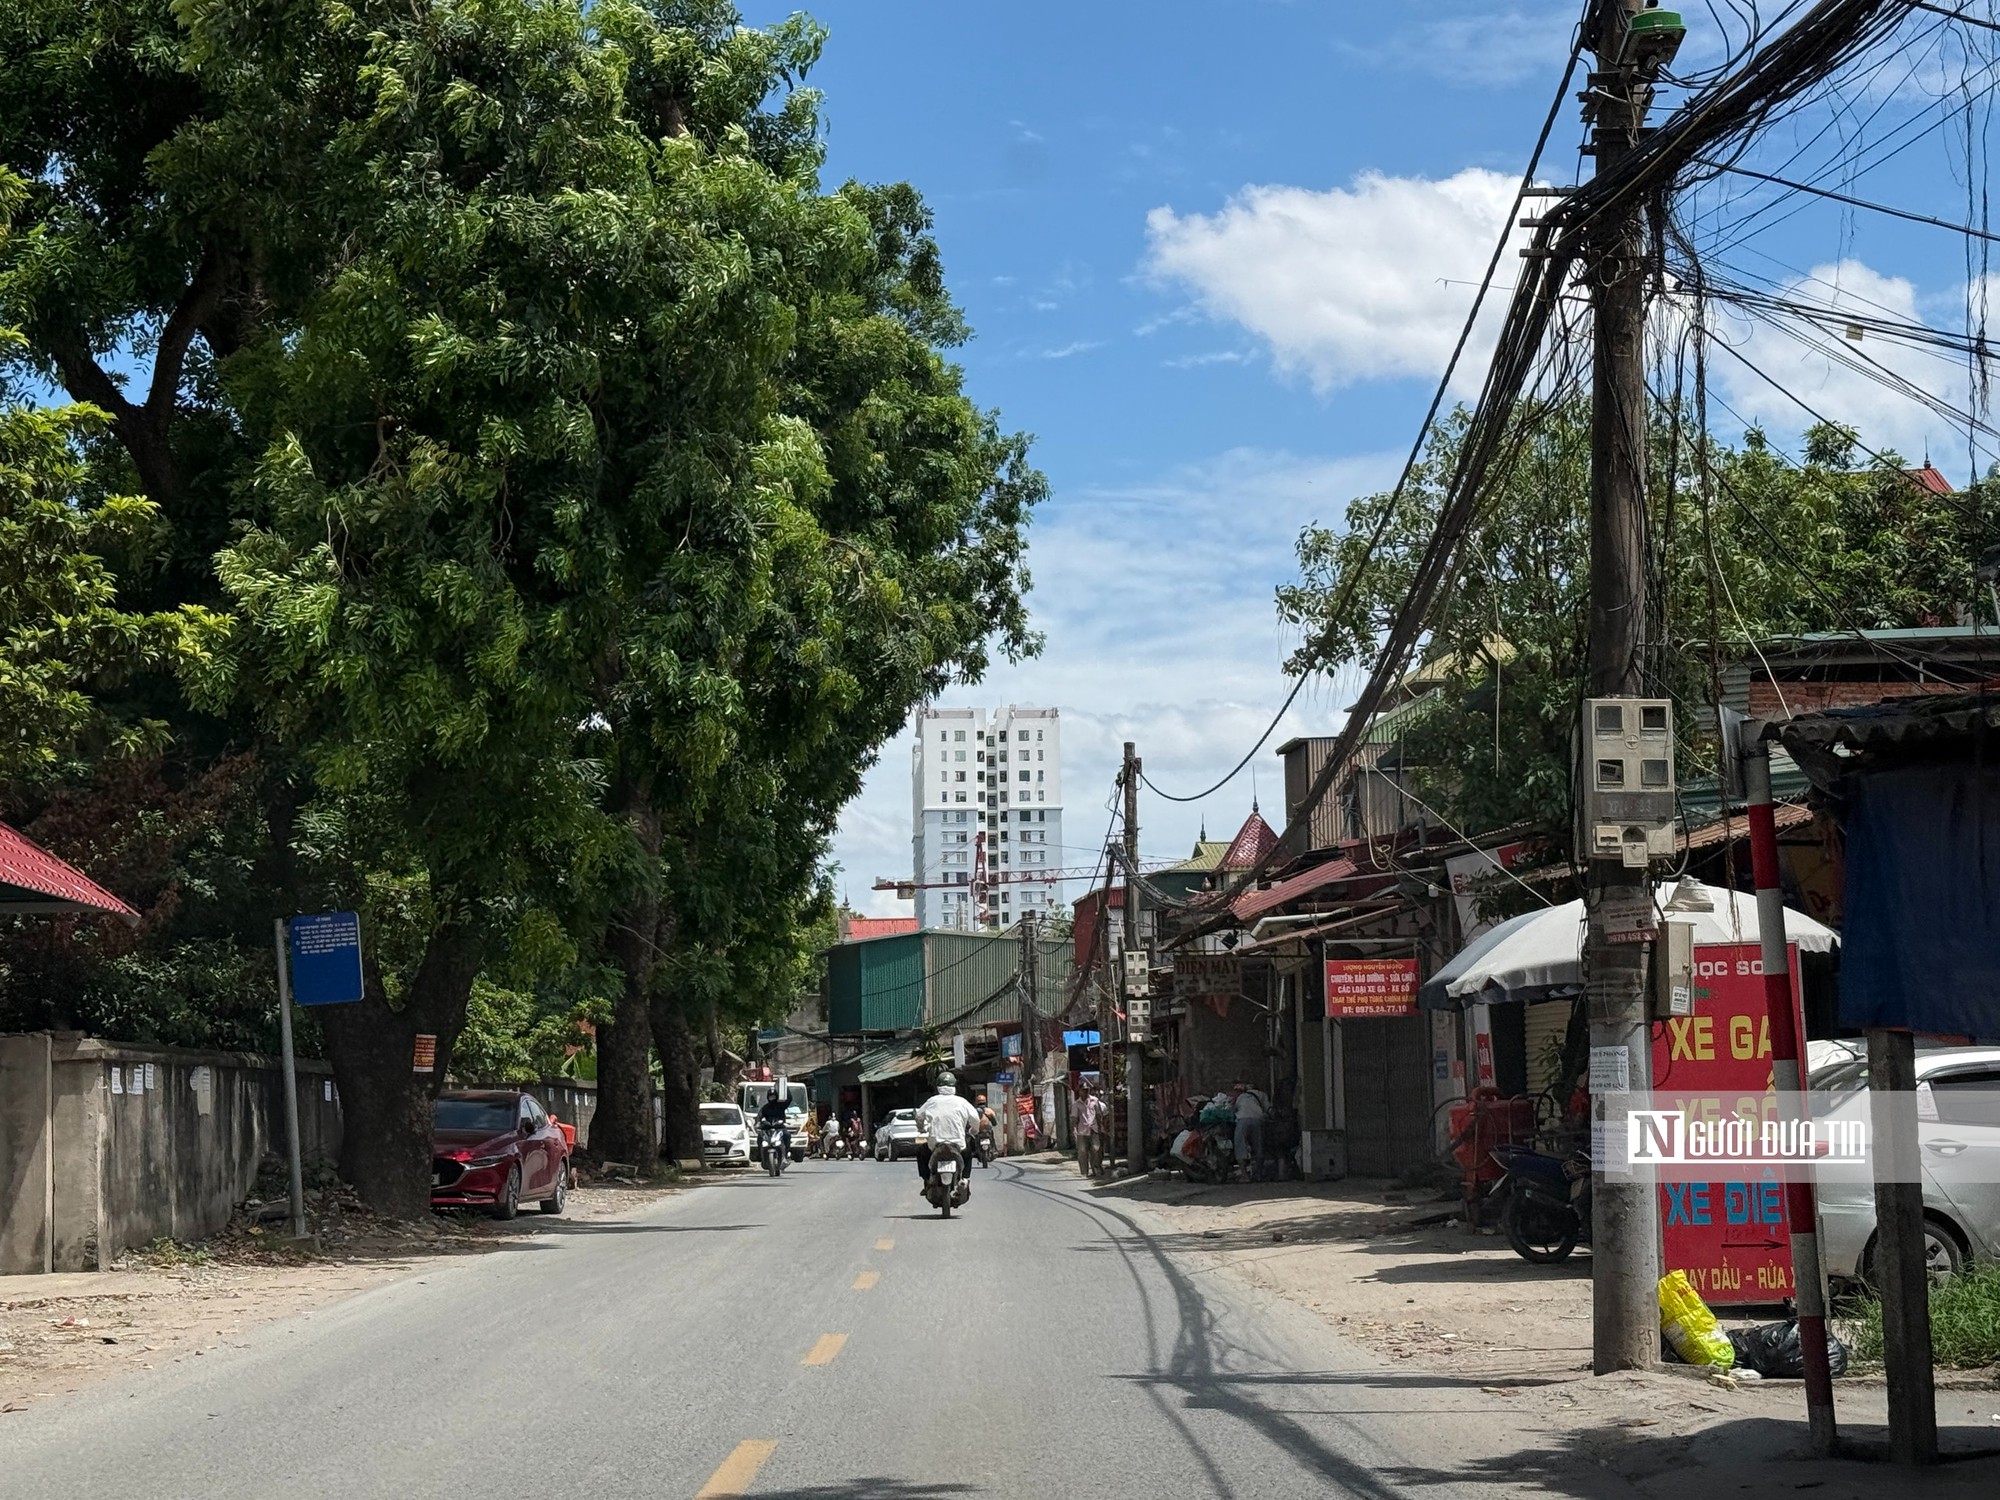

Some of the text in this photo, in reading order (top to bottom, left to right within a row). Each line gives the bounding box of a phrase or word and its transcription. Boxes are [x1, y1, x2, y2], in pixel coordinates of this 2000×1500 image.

[1337, 984, 1351, 994] CÁC
[1352, 985, 1366, 995] LOẠI
[1367, 985, 1376, 993] XE
[1377, 985, 1387, 993] GA
[1391, 984, 1400, 993] XE
[1401, 982, 1410, 992] SỐ
[1354, 971, 1366, 983] BẢO
[1389, 971, 1401, 983] SỬA
[1357, 996, 1368, 1005] PHỤ
[1668, 1015, 1773, 1061] XE GA
[1675, 1098, 1721, 1142] XE
[1665, 1167, 1789, 1236] XE ĐIỆ
[1711, 1255, 1741, 1290] DẦU
[1758, 1258, 1788, 1290] RỬA
